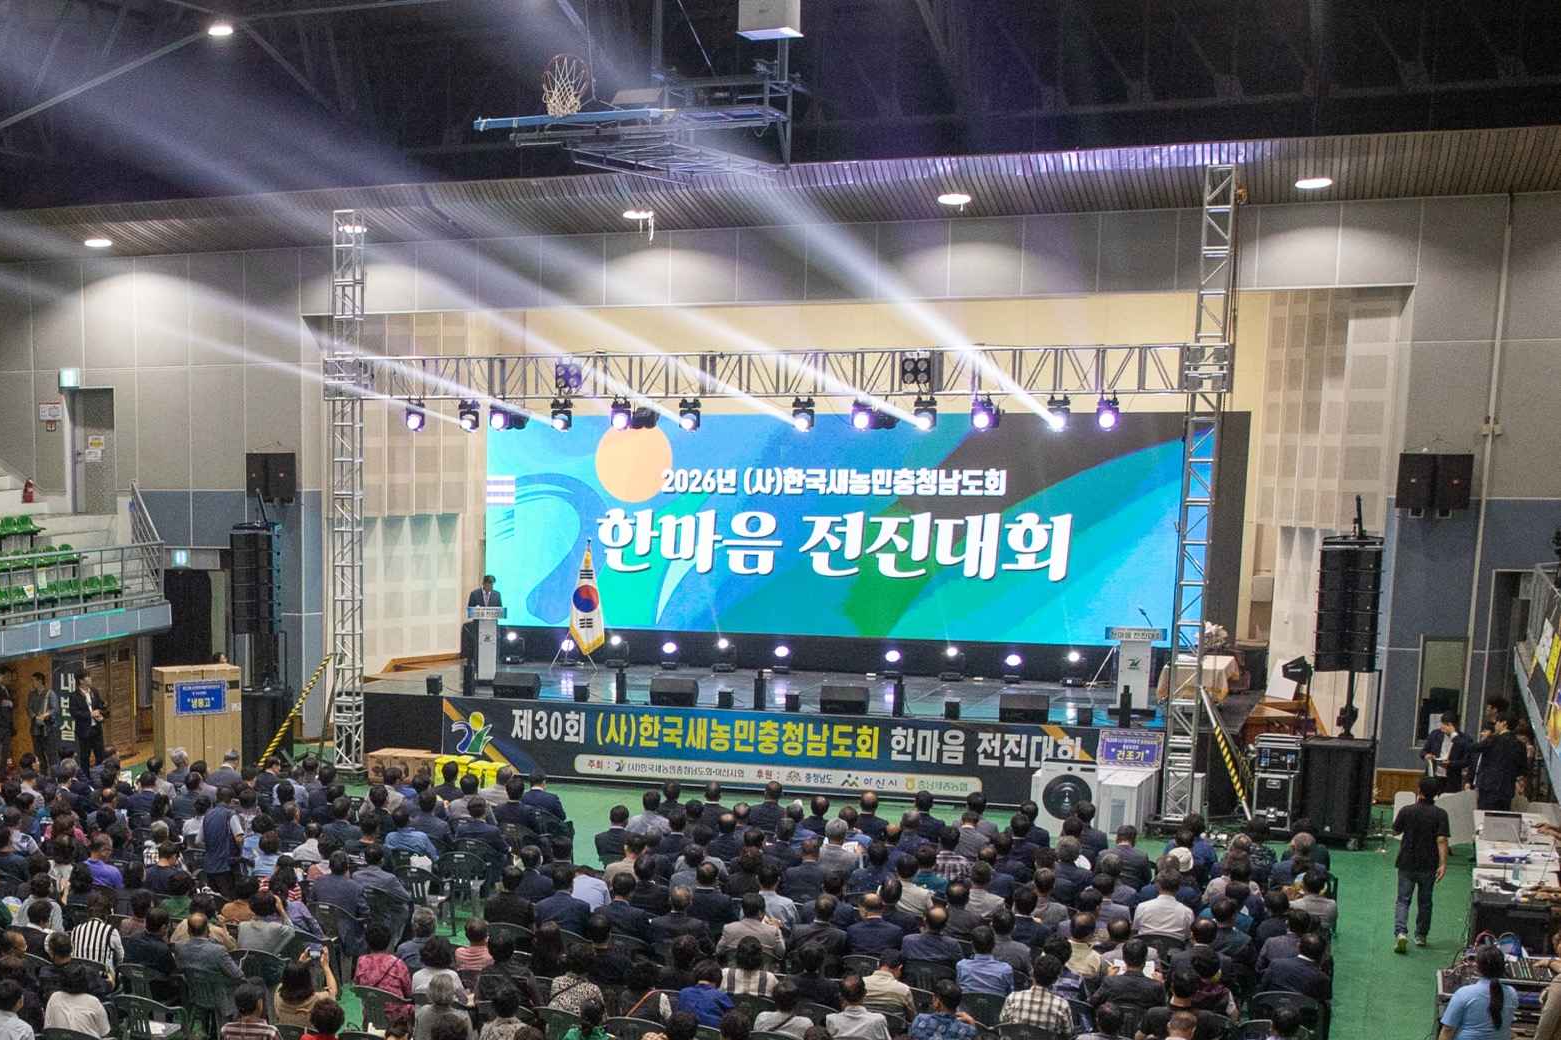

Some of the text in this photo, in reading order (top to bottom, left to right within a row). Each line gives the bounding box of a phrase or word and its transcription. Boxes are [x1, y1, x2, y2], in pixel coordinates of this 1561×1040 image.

[661, 467, 1007, 497] 2026년 (사)한국새농민충청남도회
[597, 508, 1073, 582] 한마음 전진대회
[511, 708, 586, 744] 제30회
[596, 712, 879, 760] (사)한국새농민충청남도회
[890, 726, 966, 765] 한마음
